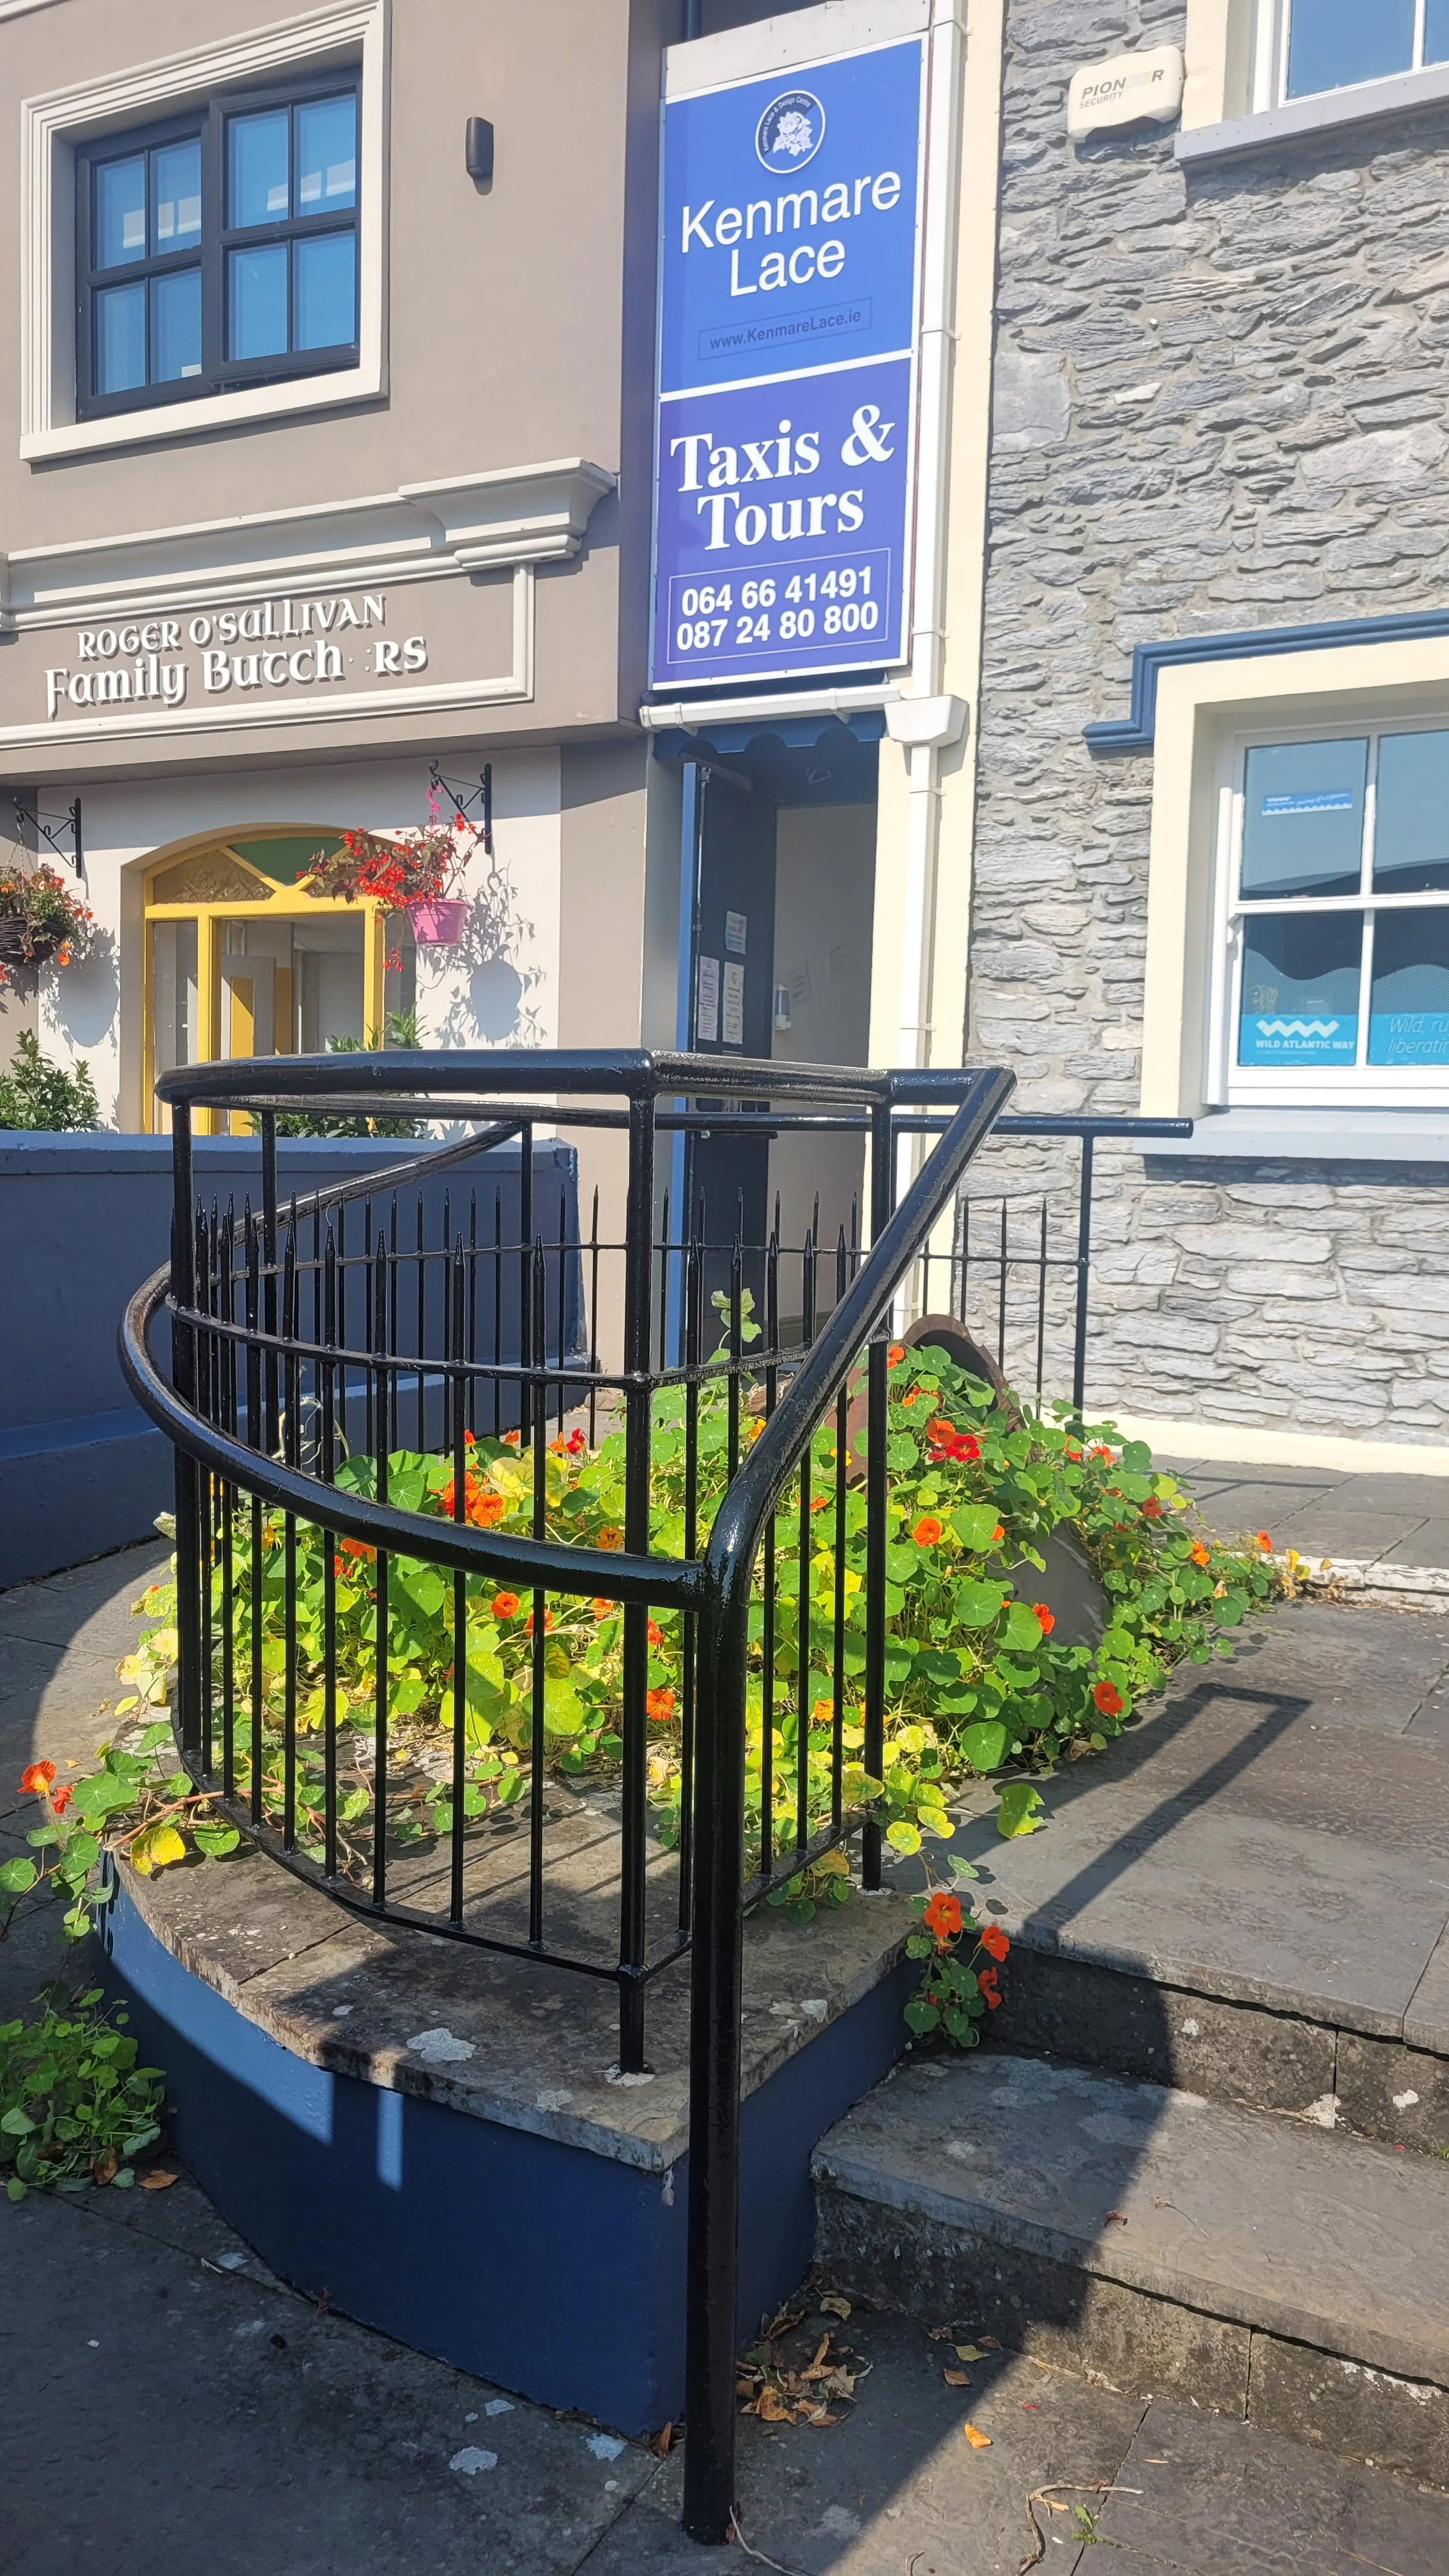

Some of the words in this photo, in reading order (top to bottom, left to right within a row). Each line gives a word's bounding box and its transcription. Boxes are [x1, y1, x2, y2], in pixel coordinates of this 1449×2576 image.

[1079, 91, 1124, 109] SECURITY
[681, 171, 901, 254] Kenmare
[730, 239, 846, 297] Lace
[709, 309, 861, 349] www.KenmareLace.ie
[670, 419, 820, 492] Taxis
[841, 404, 896, 466] &
[697, 489, 864, 551] Tours
[682, 584, 732, 617] 064
[741, 578, 776, 610] 66
[785, 566, 871, 603] 41491
[77, 620, 181, 659] ROGER
[677, 618, 728, 651] 087
[735, 614, 770, 645] 24
[779, 608, 815, 640] 80
[823, 601, 878, 634] 800
[44, 654, 187, 719] Family
[1255, 1039, 1280, 1048] WILD
[1282, 1039, 1331, 1049] ATLANTIC
[1333, 1041, 1354, 1050] WAY
